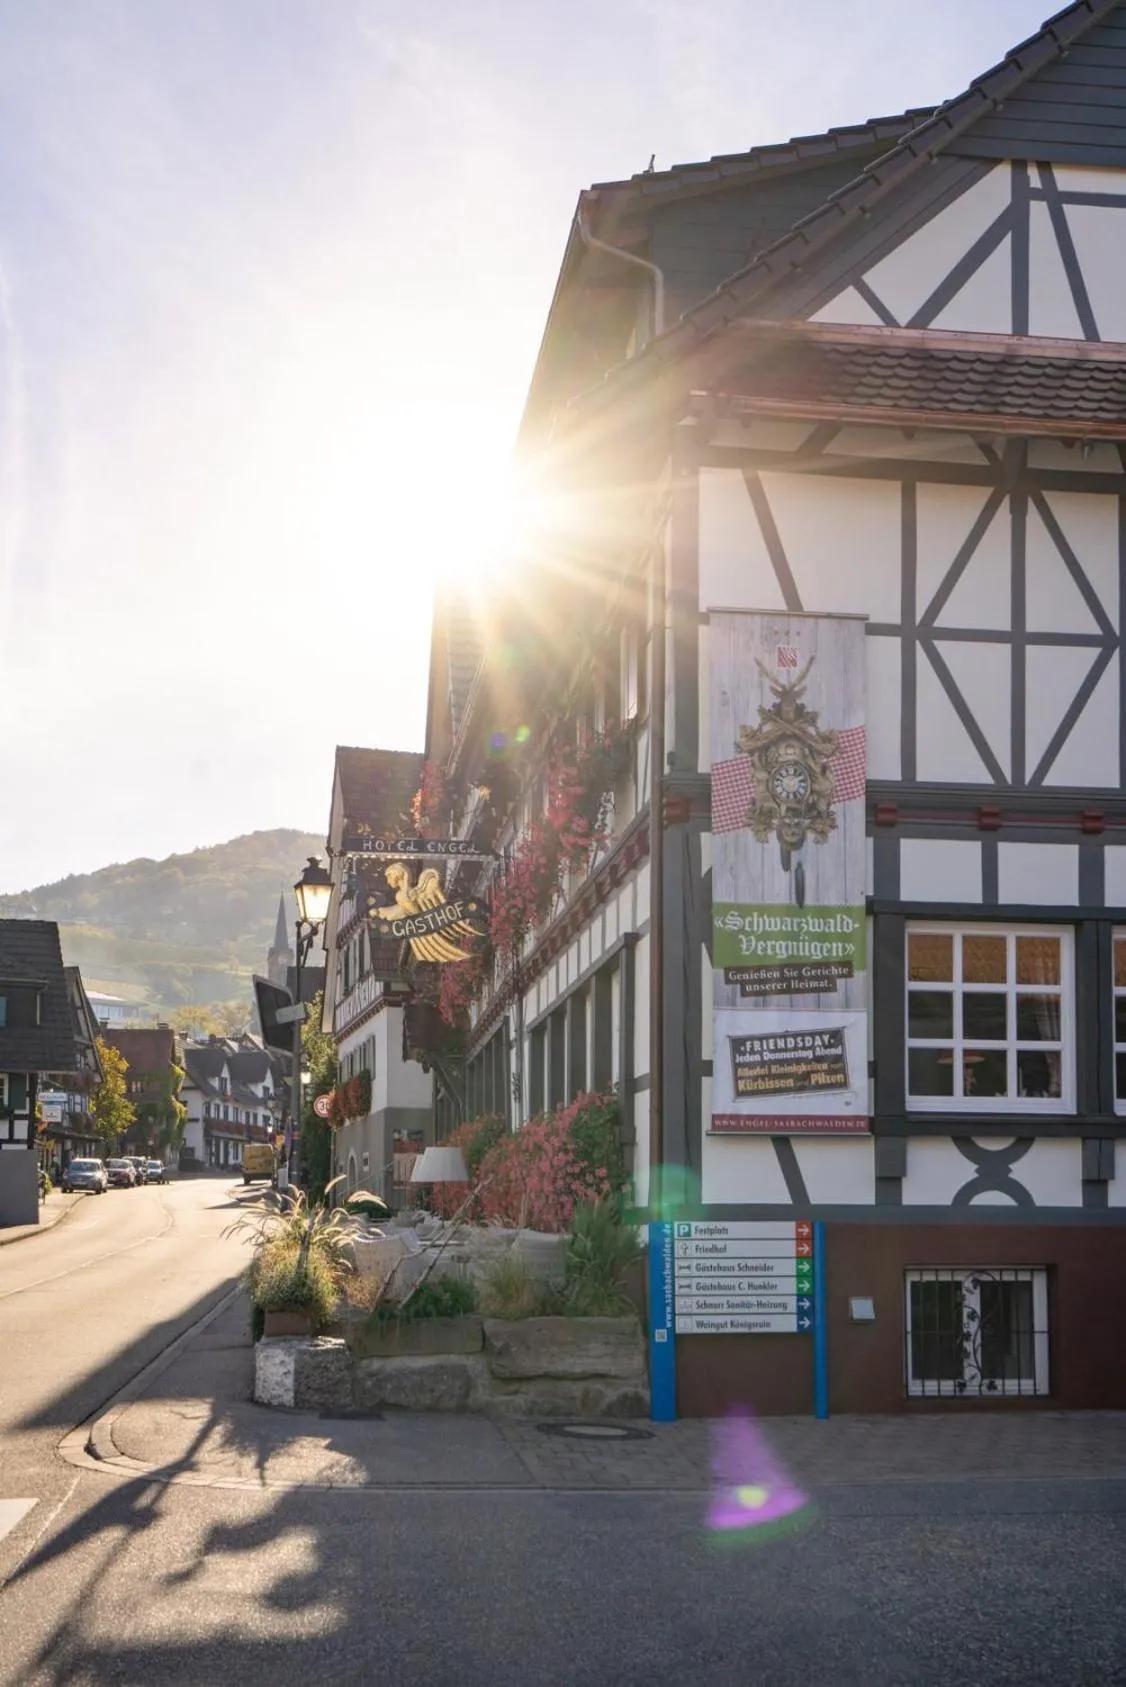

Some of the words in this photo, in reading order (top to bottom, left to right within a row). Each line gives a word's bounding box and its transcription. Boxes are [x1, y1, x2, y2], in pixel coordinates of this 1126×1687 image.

[363, 839, 419, 852] HOTEL
[426, 841, 482, 854] ENGEL
[392, 900, 465, 937] GASTHOF
[728, 969, 780, 981] Genießen
[783, 968, 799, 978] Sie
[801, 966, 849, 978] Gerichte
[745, 981, 787, 992] unserer
[790, 979, 833, 990] Heimat.
[735, 1053, 761, 1063] Jeden
[763, 1050, 813, 1061] Donnerstag
[815, 1046, 842, 1056] Abend
[737, 1078, 794, 1093] Kürbissen
[810, 1073, 845, 1085] Pilzen
[695, 1244, 727, 1254] Friedhof
[695, 1263, 735, 1272] Gästehaus
[737, 1262, 775, 1272] Schneider
[662, 1223, 673, 1328] www.sasbachwalden.de
[695, 1282, 735, 1291] Gästehaus
[696, 1320, 728, 1331] Weingut
